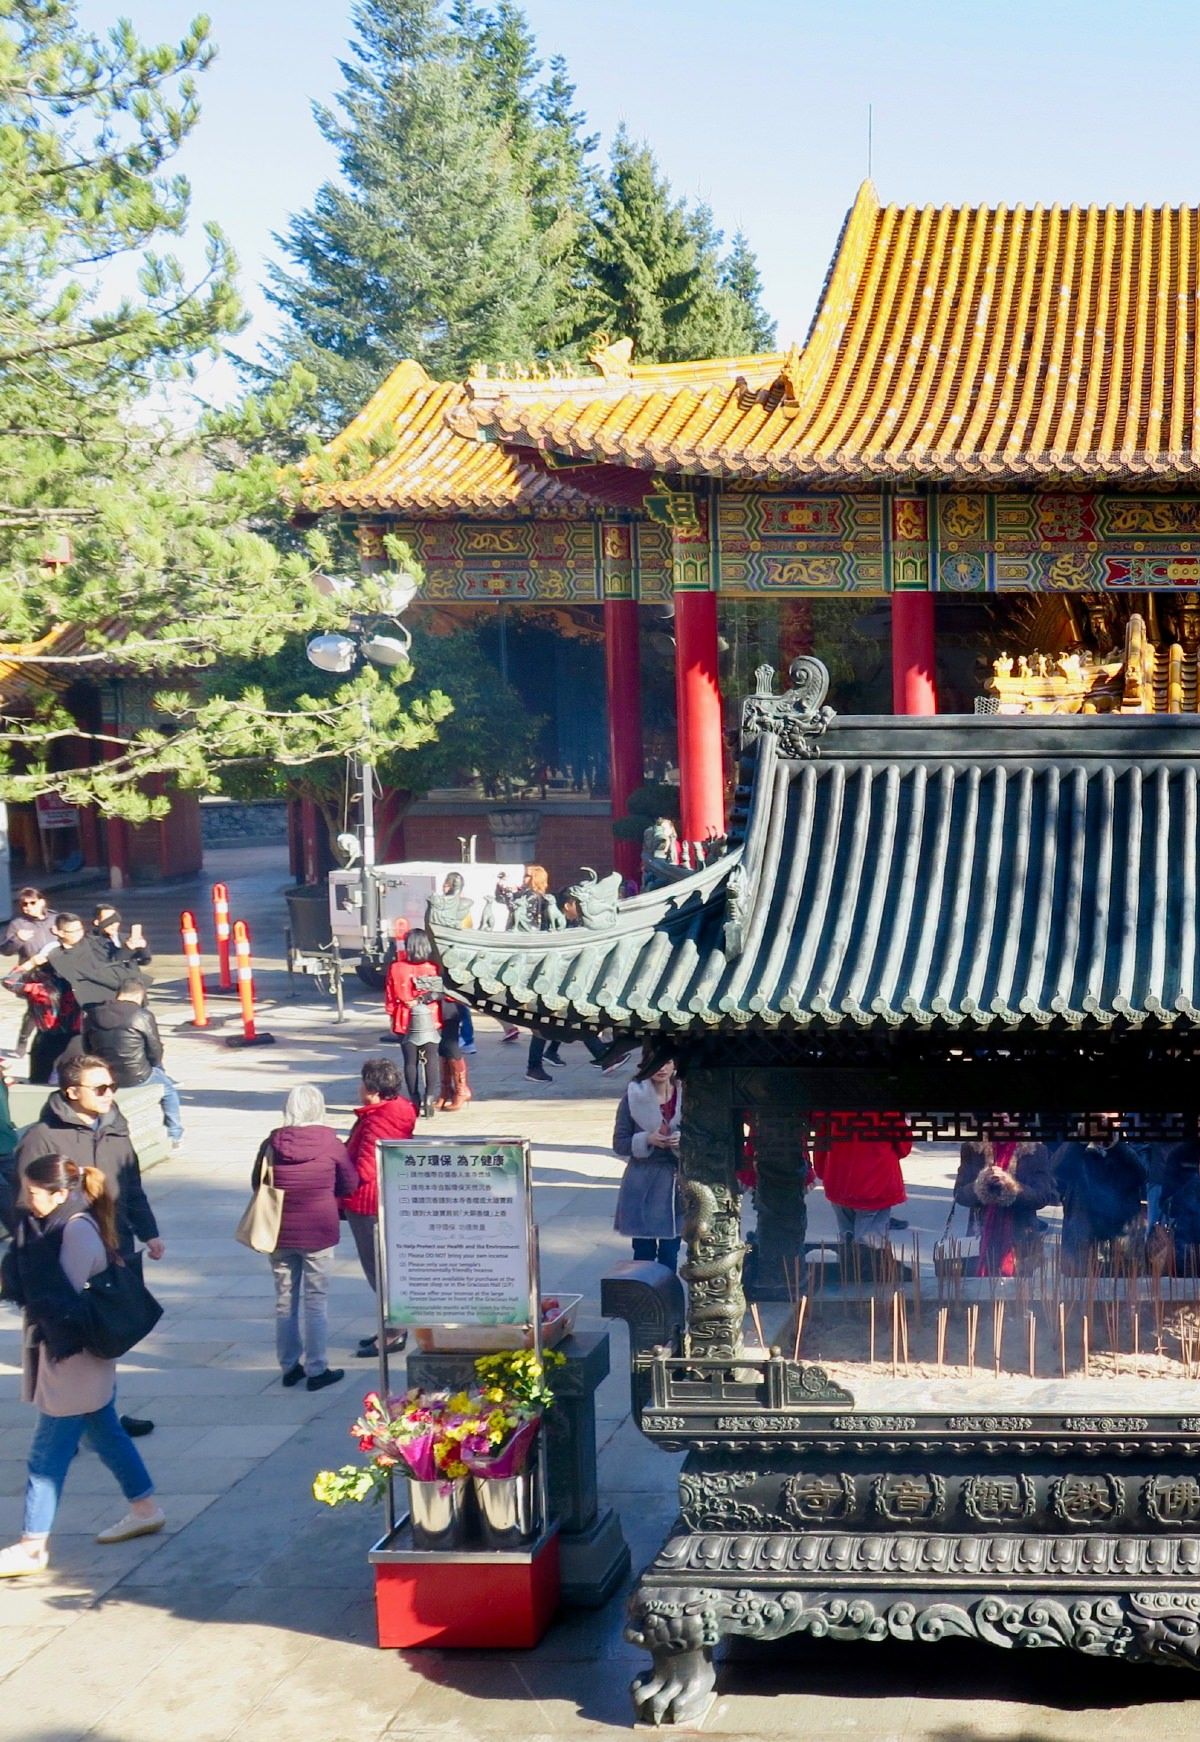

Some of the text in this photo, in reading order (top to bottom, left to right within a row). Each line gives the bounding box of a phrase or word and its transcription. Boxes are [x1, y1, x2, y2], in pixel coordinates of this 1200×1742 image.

[404, 1155, 504, 1166] 為了環保 為了健康
